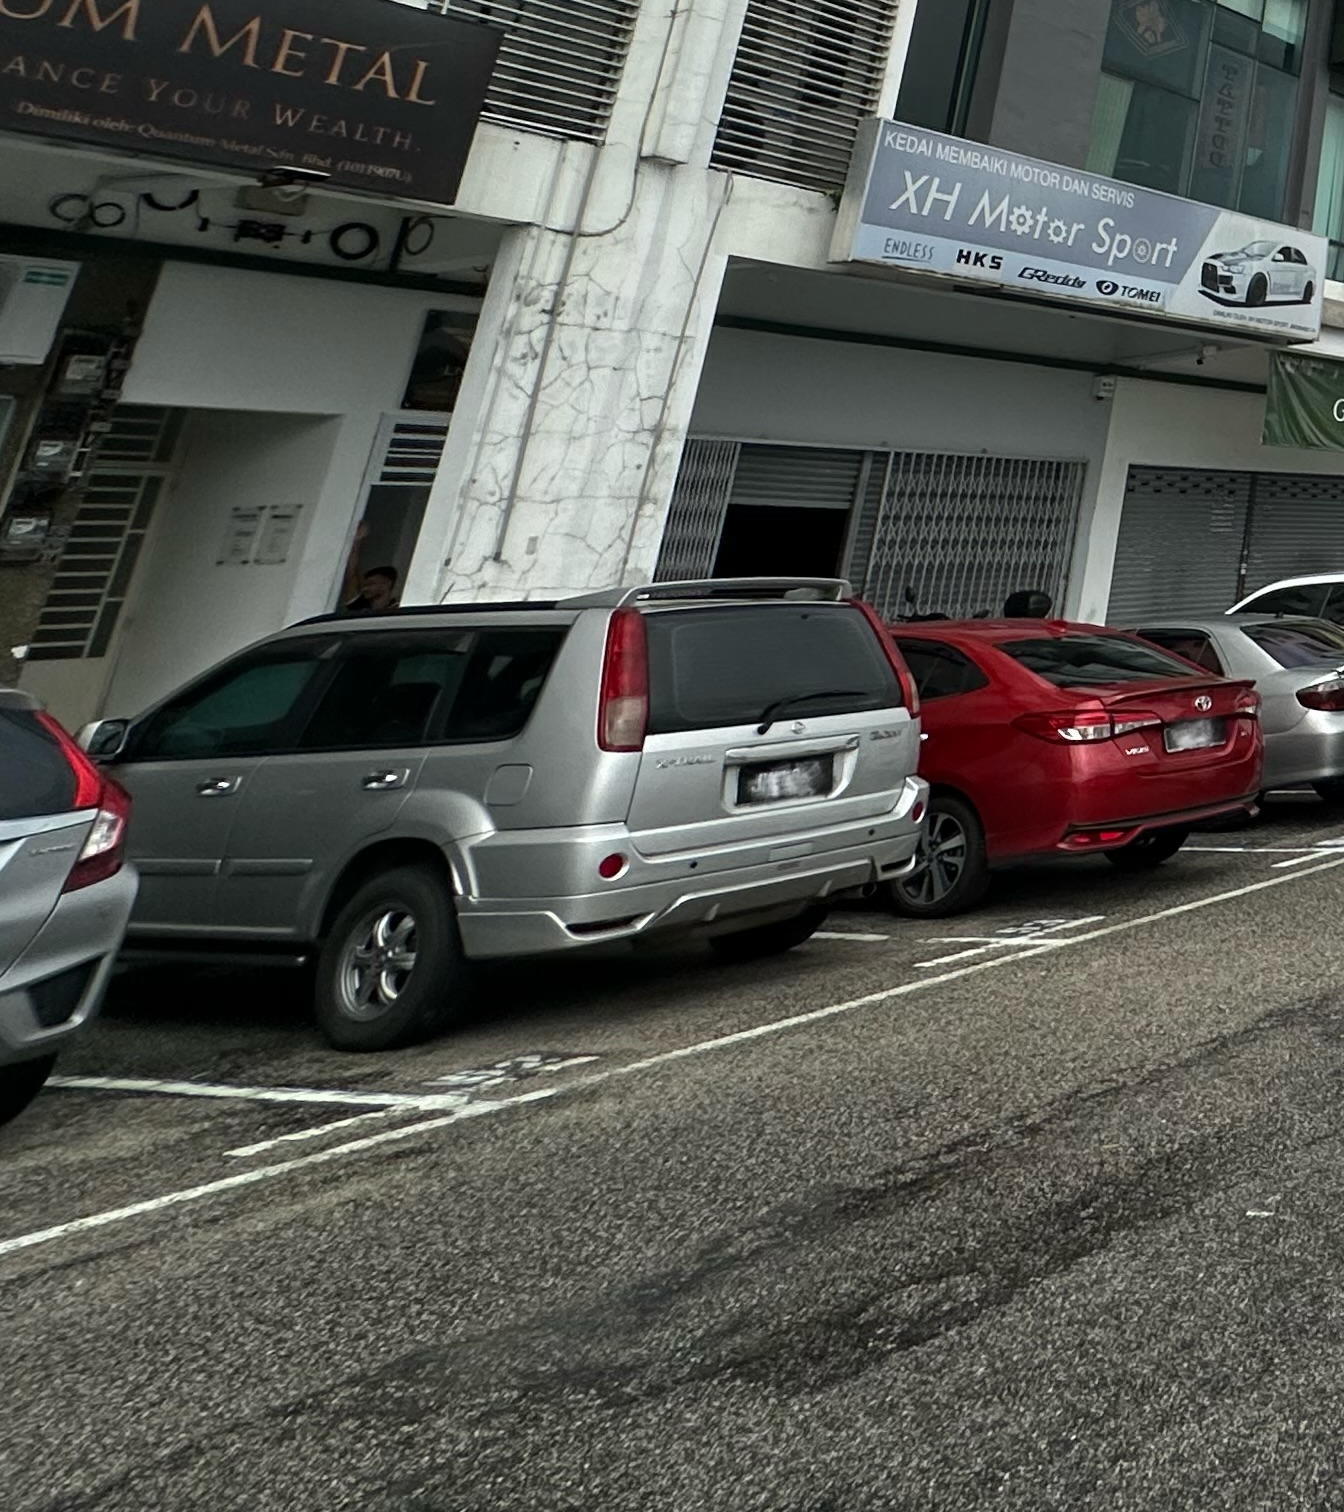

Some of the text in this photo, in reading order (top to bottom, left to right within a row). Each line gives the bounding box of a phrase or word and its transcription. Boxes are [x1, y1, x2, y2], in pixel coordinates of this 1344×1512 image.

[177, 4, 437, 106] METAL
[148, 78, 251, 119] YOUR
[884, 130, 1136, 209] KEDAI MEMBAIKI MOTOR DAN SERVIS
[888, 170, 1179, 268] XH Motor Sport
[883, 237, 1162, 303] ENDLESS HKS GReddy TOMEI
